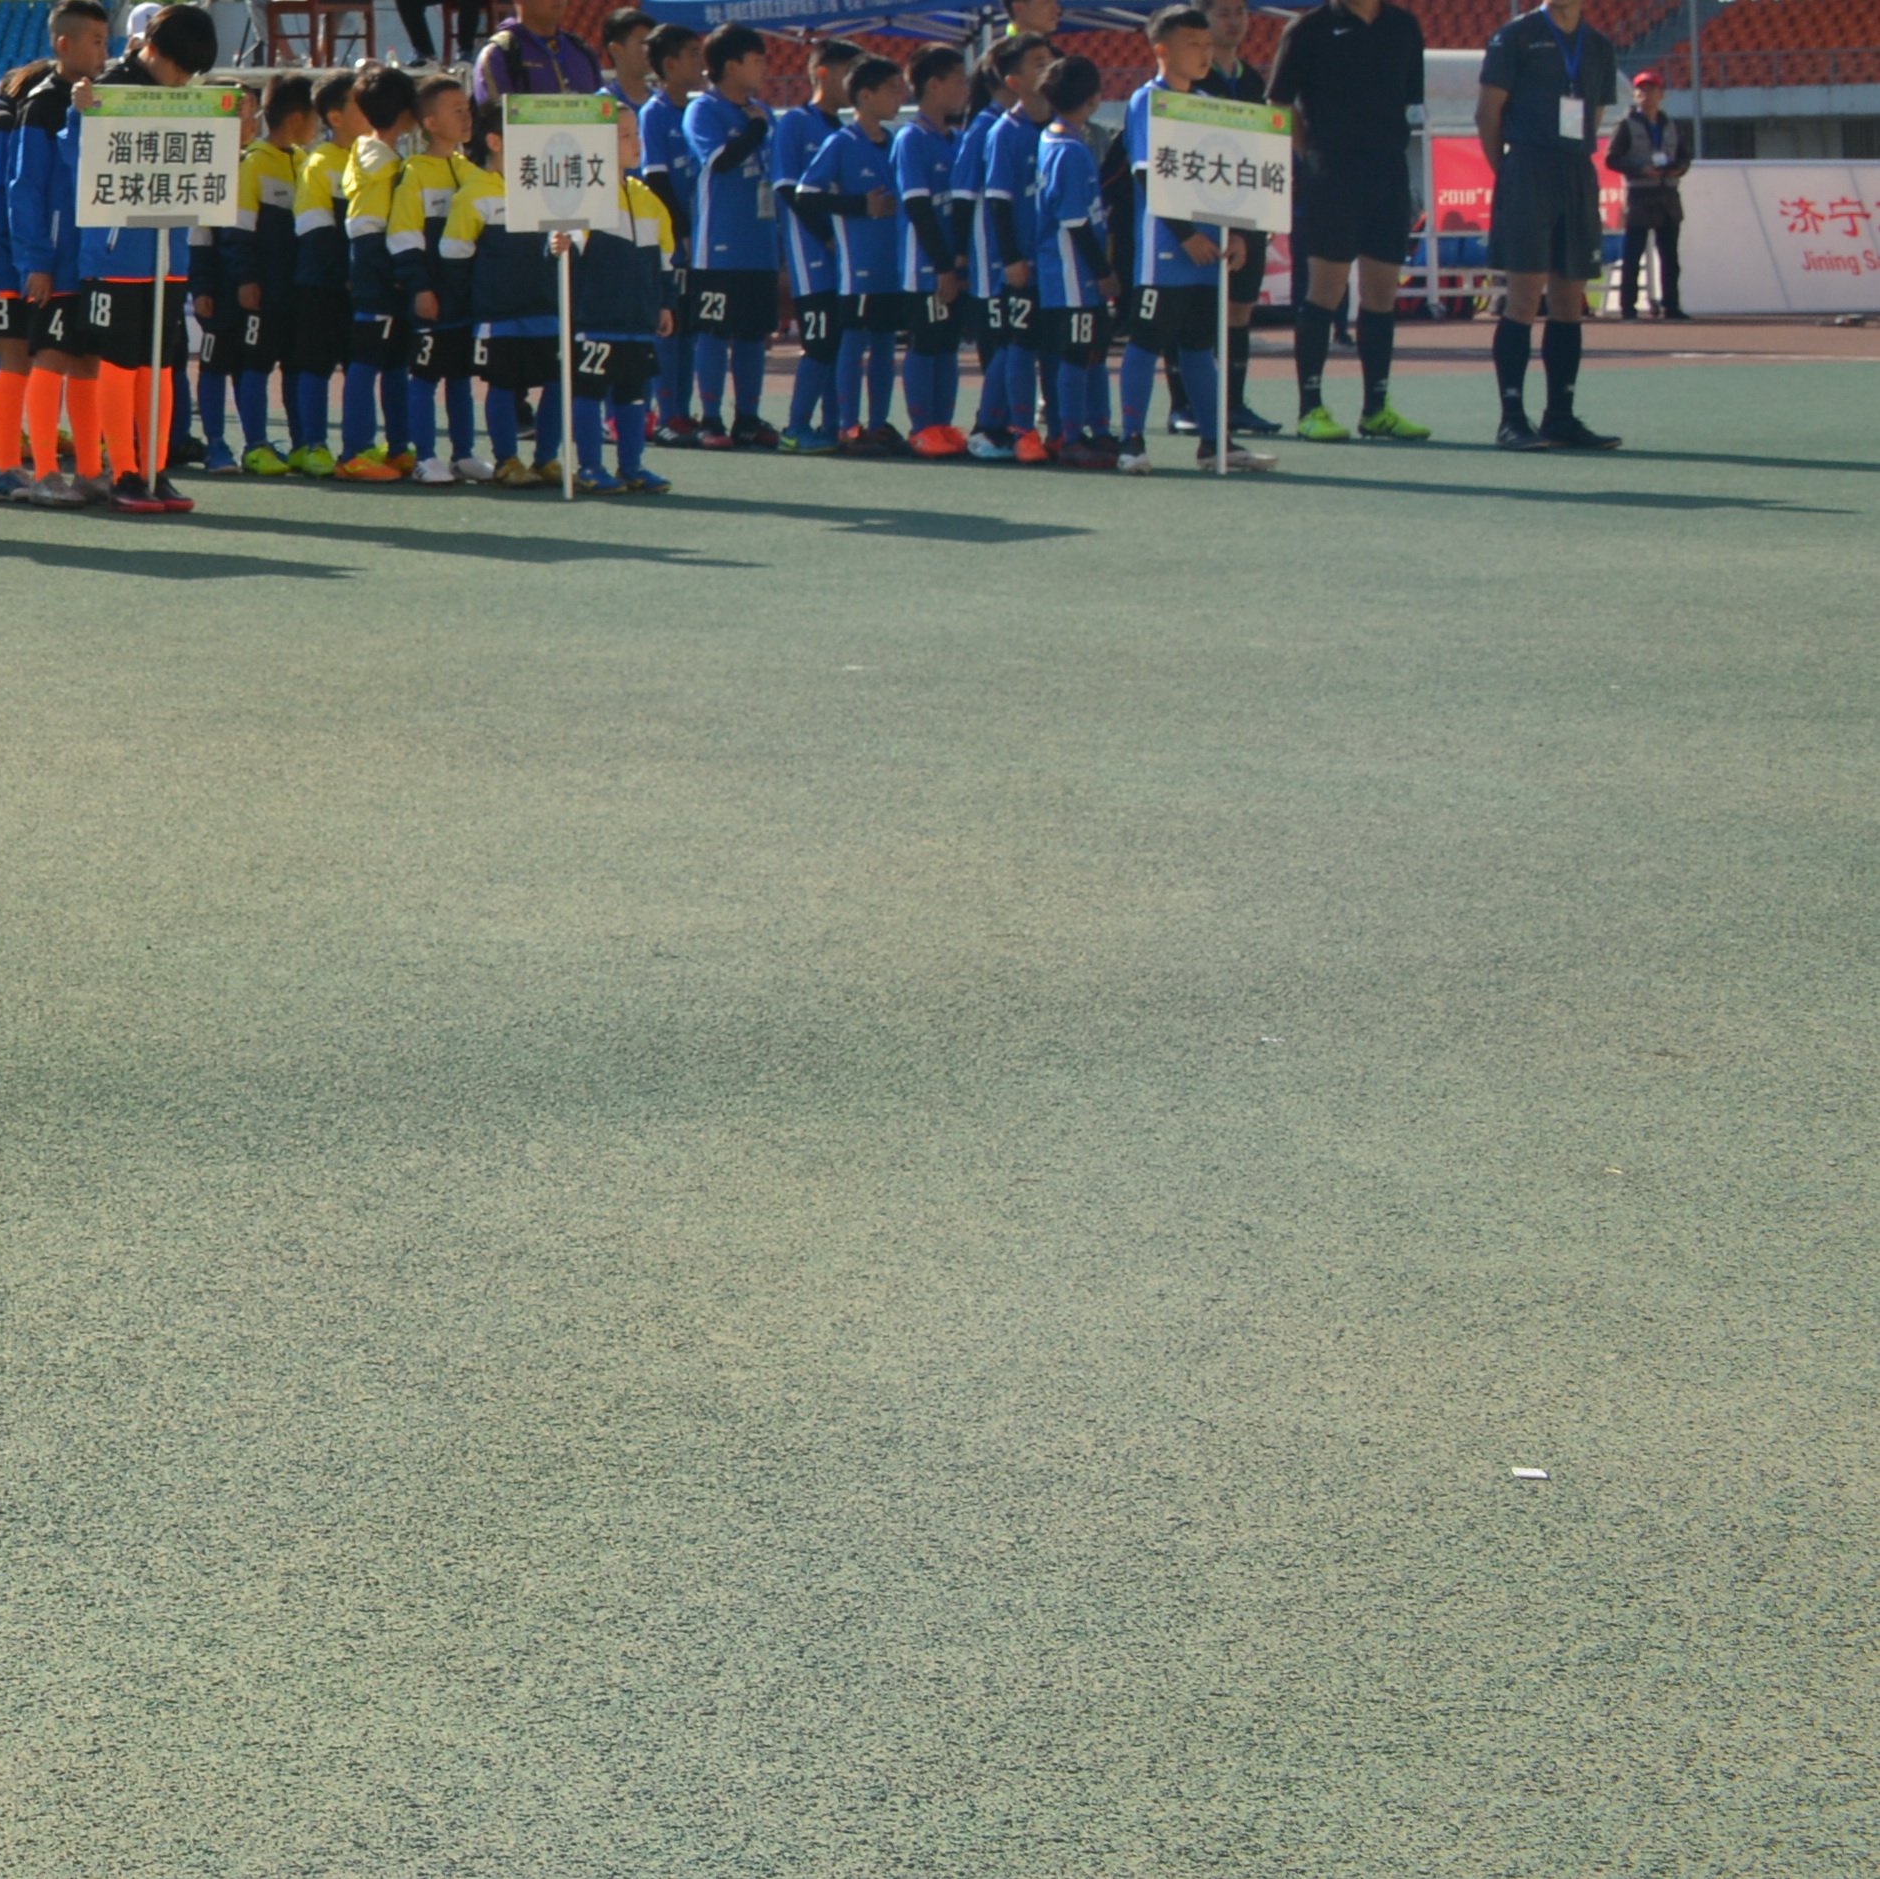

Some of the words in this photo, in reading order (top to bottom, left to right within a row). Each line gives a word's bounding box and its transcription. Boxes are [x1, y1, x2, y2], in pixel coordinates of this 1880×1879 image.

[107, 131, 216, 165] 淄博圆茵
[519, 154, 606, 190] 泰山博文
[1156, 146, 1285, 195] 泰安大白峪
[91, 172, 227, 206] 足球俱乐部
[1779, 196, 1880, 238] 济宁
[1802, 251, 1862, 276] Jining
[89, 290, 112, 327] 18
[699, 291, 727, 321] 23
[1139, 288, 1159, 320] 9
[47, 308, 64, 342] 4
[244, 315, 261, 346] 8
[804, 310, 827, 341] 21
[1071, 312, 1094, 344] 18
[416, 335, 434, 367] 3
[578, 340, 611, 376] 22
